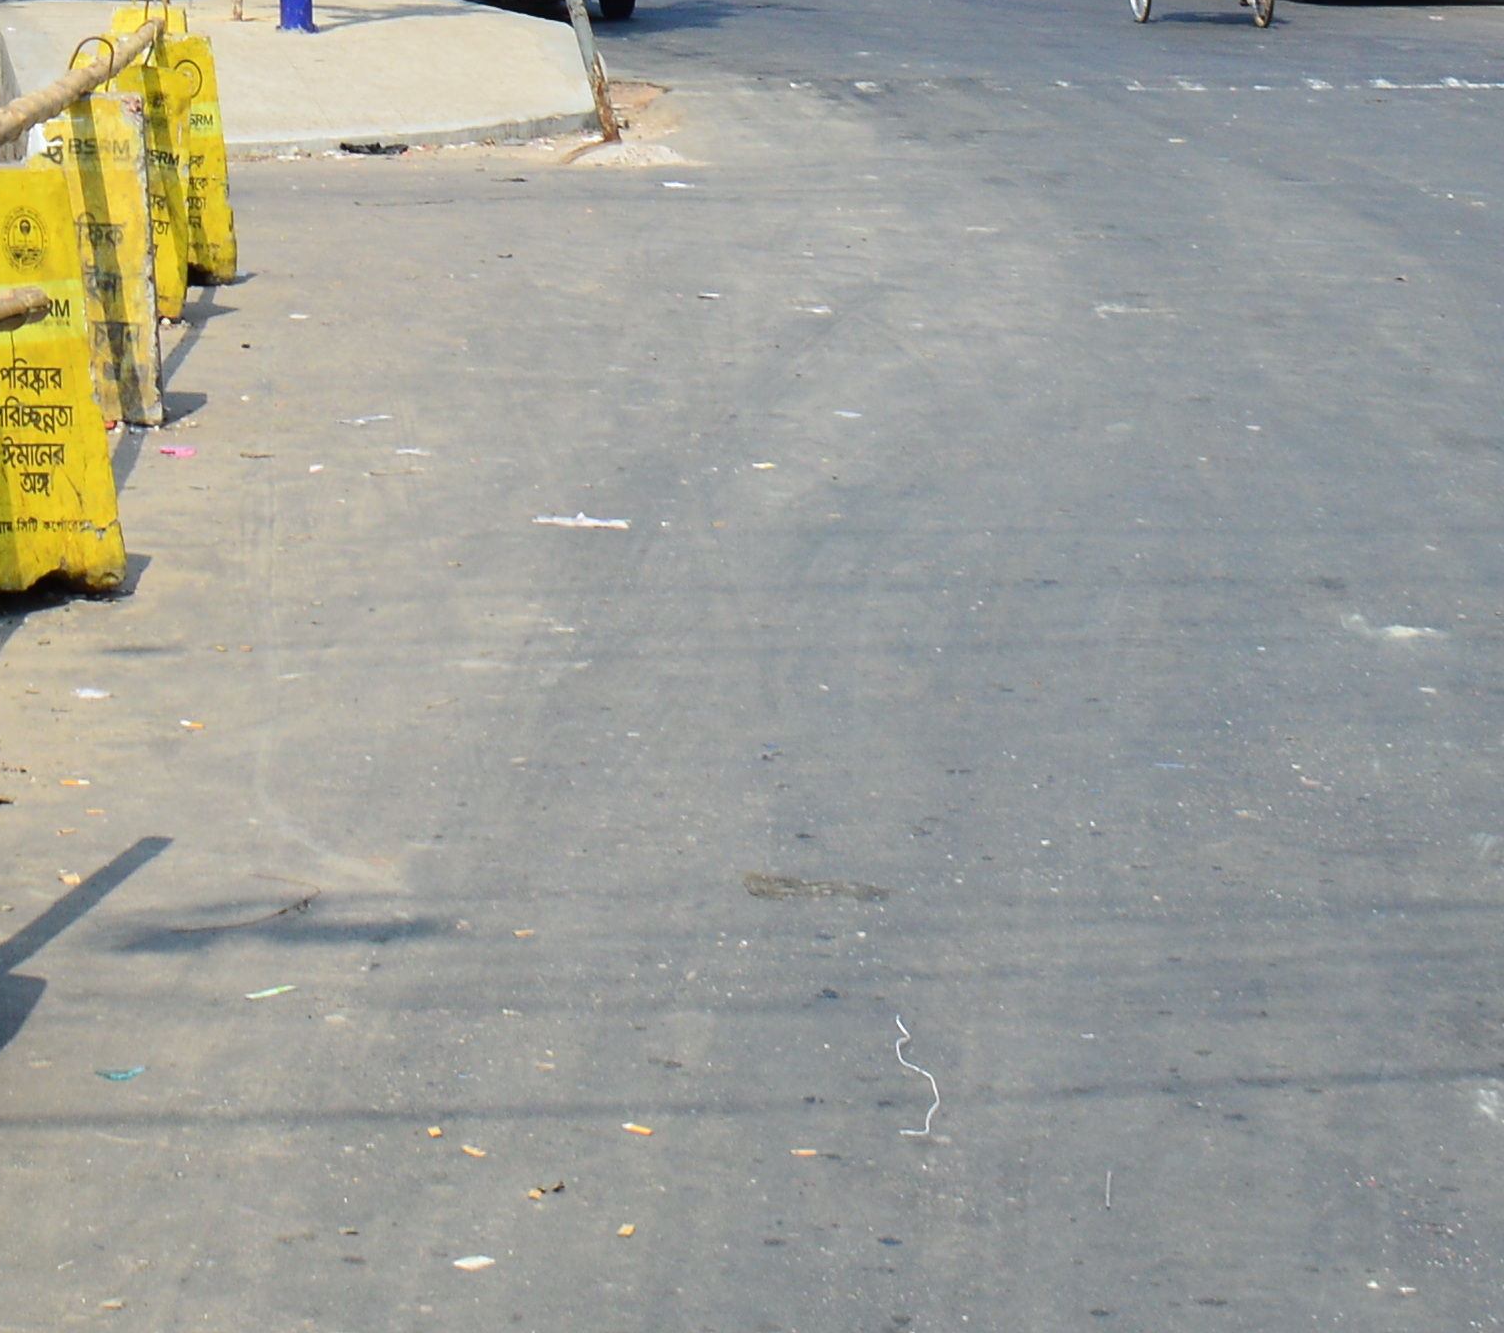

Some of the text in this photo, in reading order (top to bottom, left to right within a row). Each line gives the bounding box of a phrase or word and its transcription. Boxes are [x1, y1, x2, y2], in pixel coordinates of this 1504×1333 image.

[190, 113, 214, 127] SRM
[0, 358, 62, 396] পরিষ্কার
[0, 437, 65, 468] ঈমানের
[20, 472, 50, 497] অঙ্গ
